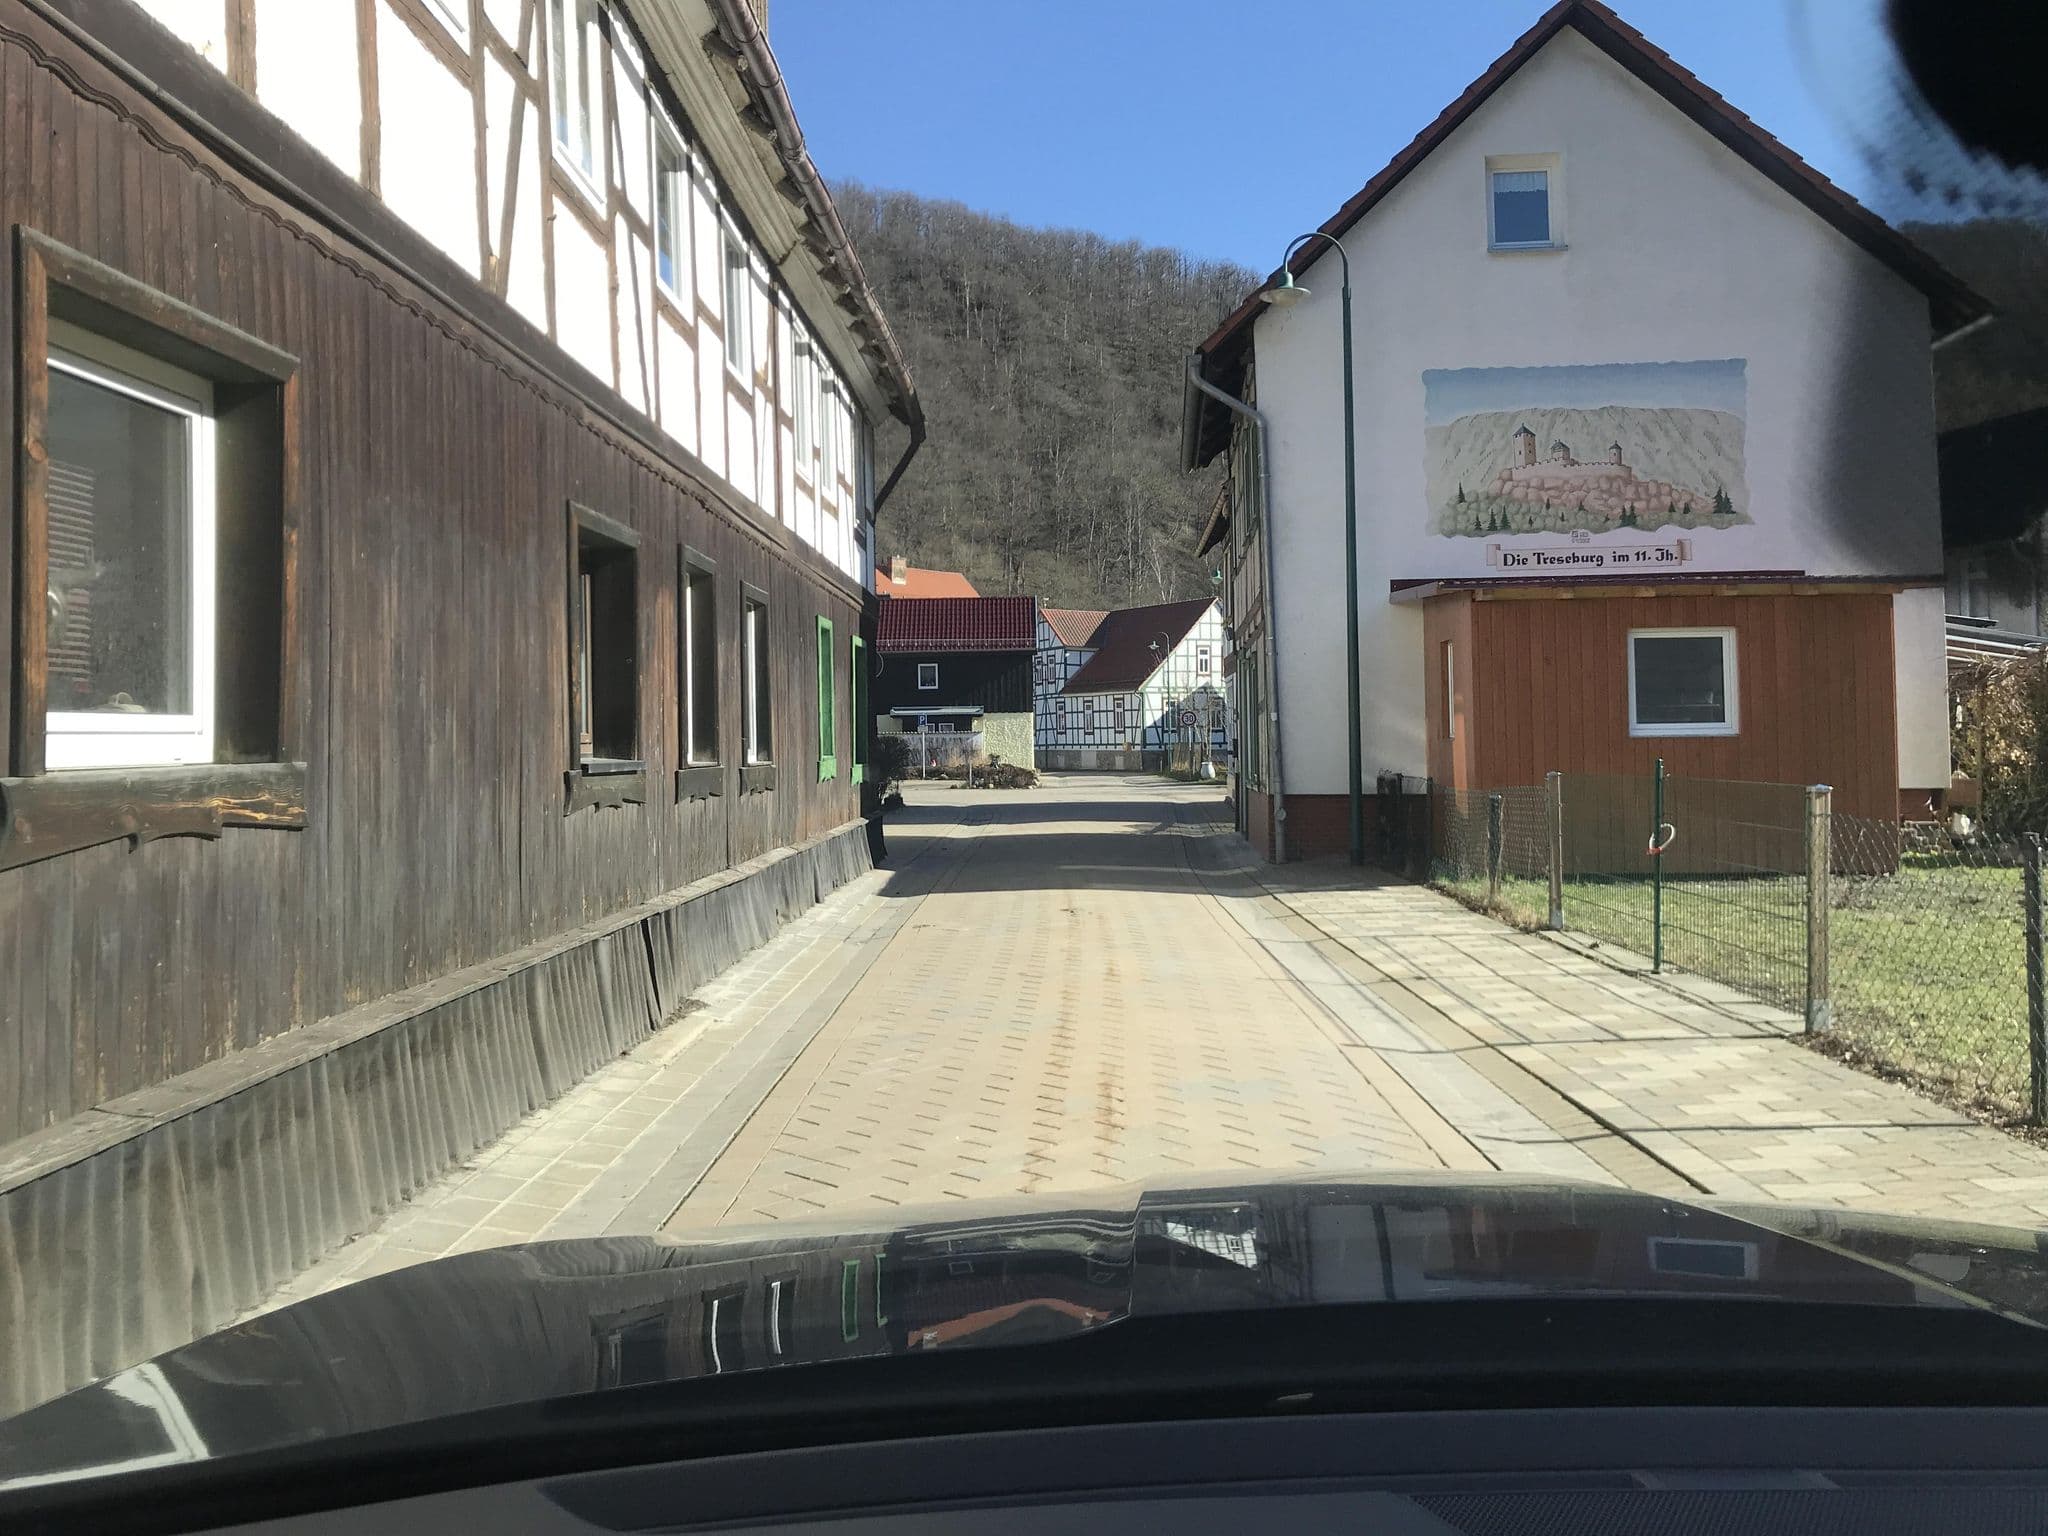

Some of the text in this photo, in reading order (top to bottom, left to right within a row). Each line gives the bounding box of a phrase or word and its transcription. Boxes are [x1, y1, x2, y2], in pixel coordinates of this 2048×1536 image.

[1503, 548, 1678, 567] Die Treseburg im 11. Jh.
[1184, 714, 1194, 723] 30
